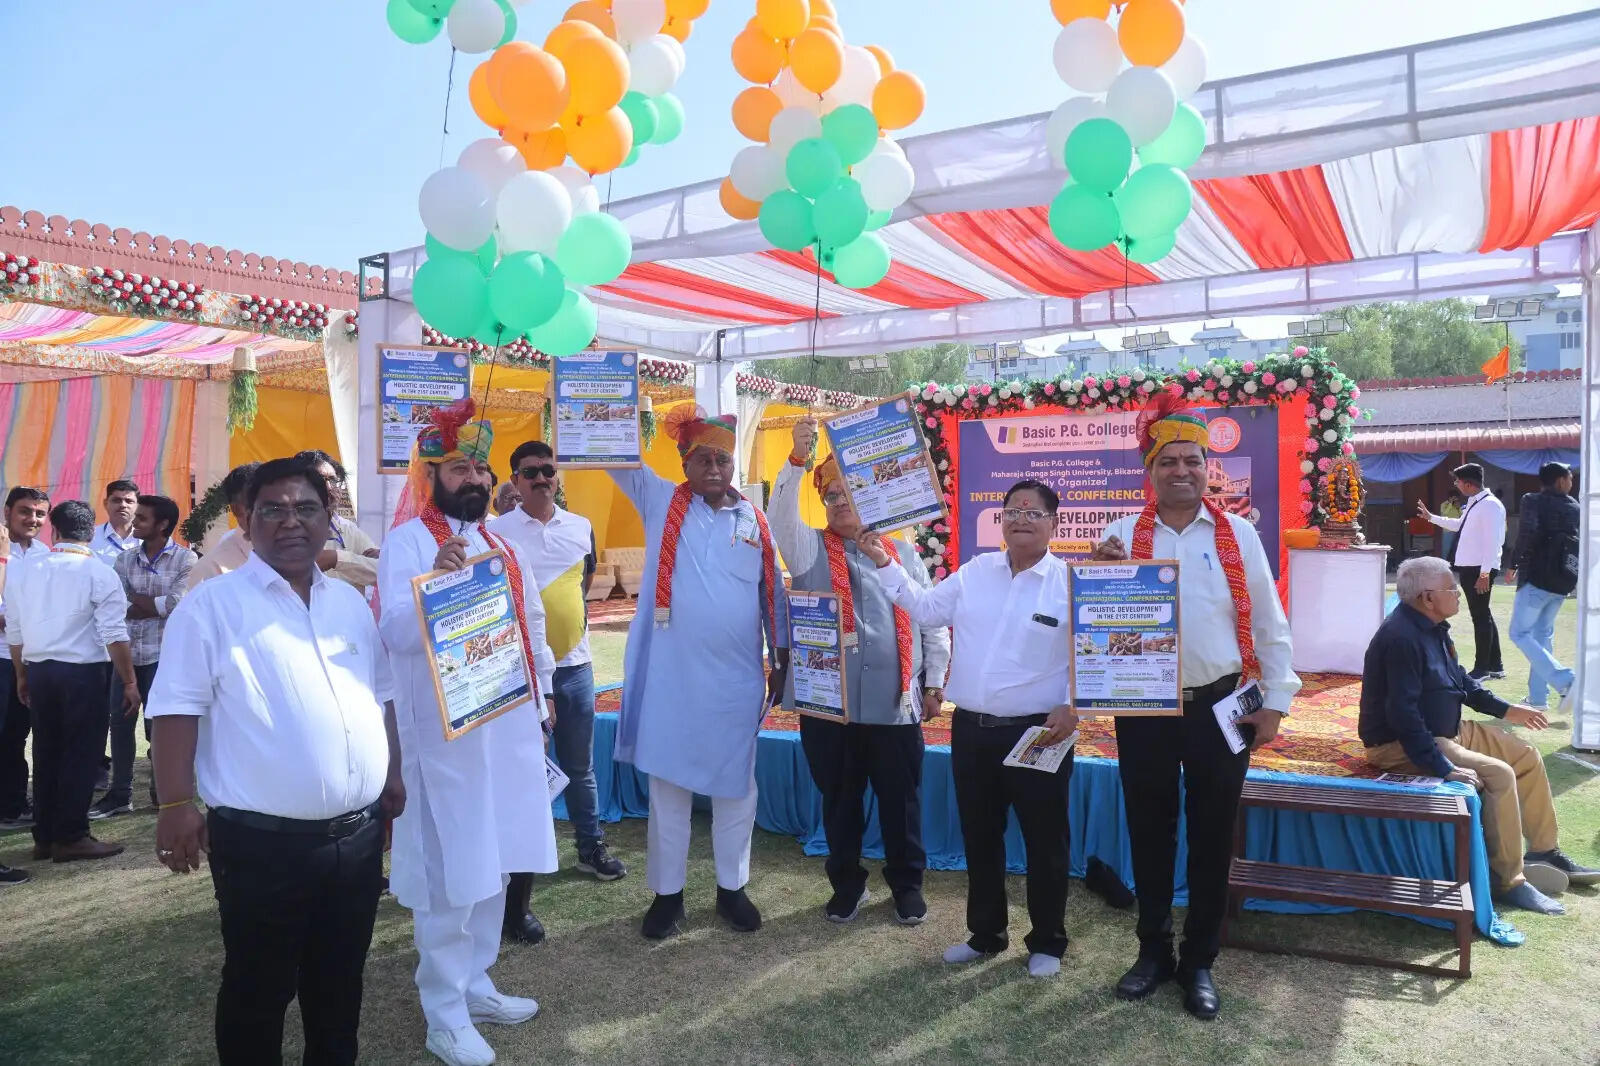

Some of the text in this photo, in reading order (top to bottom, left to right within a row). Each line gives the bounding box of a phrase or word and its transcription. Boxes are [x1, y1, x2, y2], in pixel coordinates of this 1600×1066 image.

[1022, 423, 1136, 439] Basic P.G. College
[1066, 459, 1093, 468] College
[991, 470, 1024, 478] Maharaja
[1025, 470, 1048, 479] Ganga
[1050, 470, 1070, 479] Singh
[1073, 468, 1113, 477] University,
[1058, 477, 1108, 488] Organized
[1055, 528, 1106, 538] 1ST CENT
[441, 599, 500, 628] HOLISTIC DEVELOPMENT
